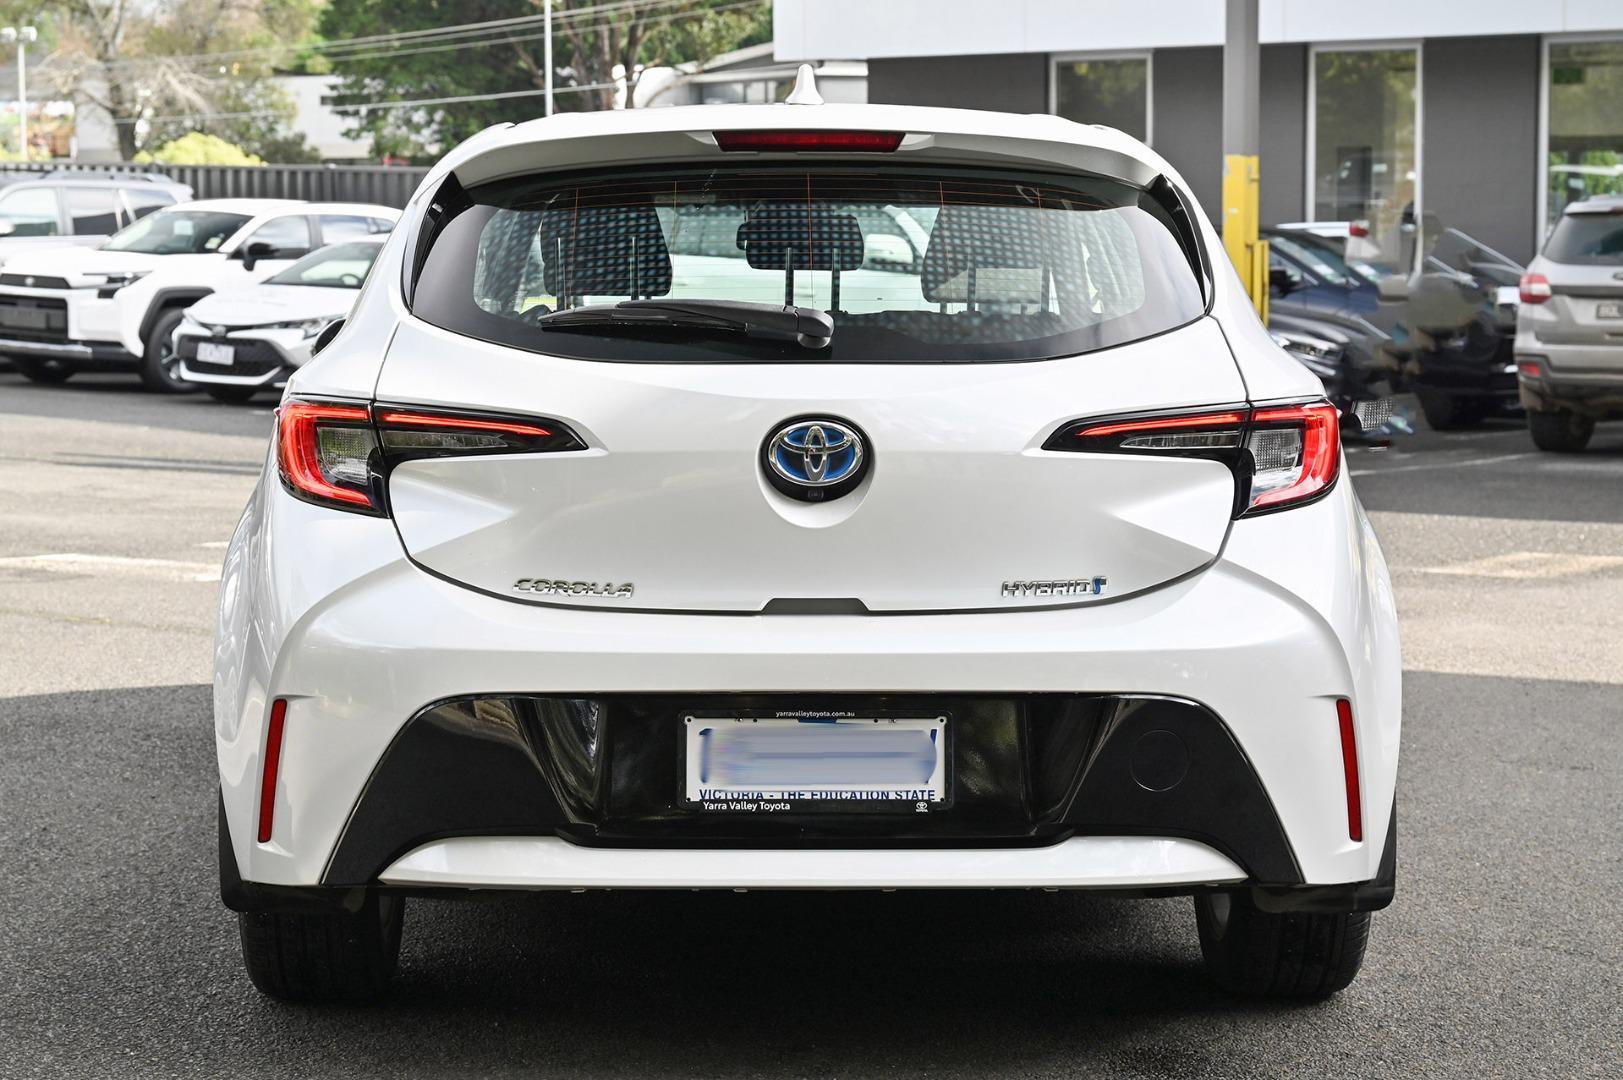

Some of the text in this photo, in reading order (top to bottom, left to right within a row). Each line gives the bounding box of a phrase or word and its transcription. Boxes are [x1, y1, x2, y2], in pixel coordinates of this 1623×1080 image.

[512, 579, 633, 598] COROLLA
[1002, 580, 1090, 597] HYBRID
[775, 710, 855, 718] yarravalleytoyota.com.au
[699, 789, 764, 800] VICTORIA
[811, 790, 889, 800] EDUCATION
[895, 789, 935, 800] STATE
[703, 801, 791, 812] Yarra Valley Toyota
